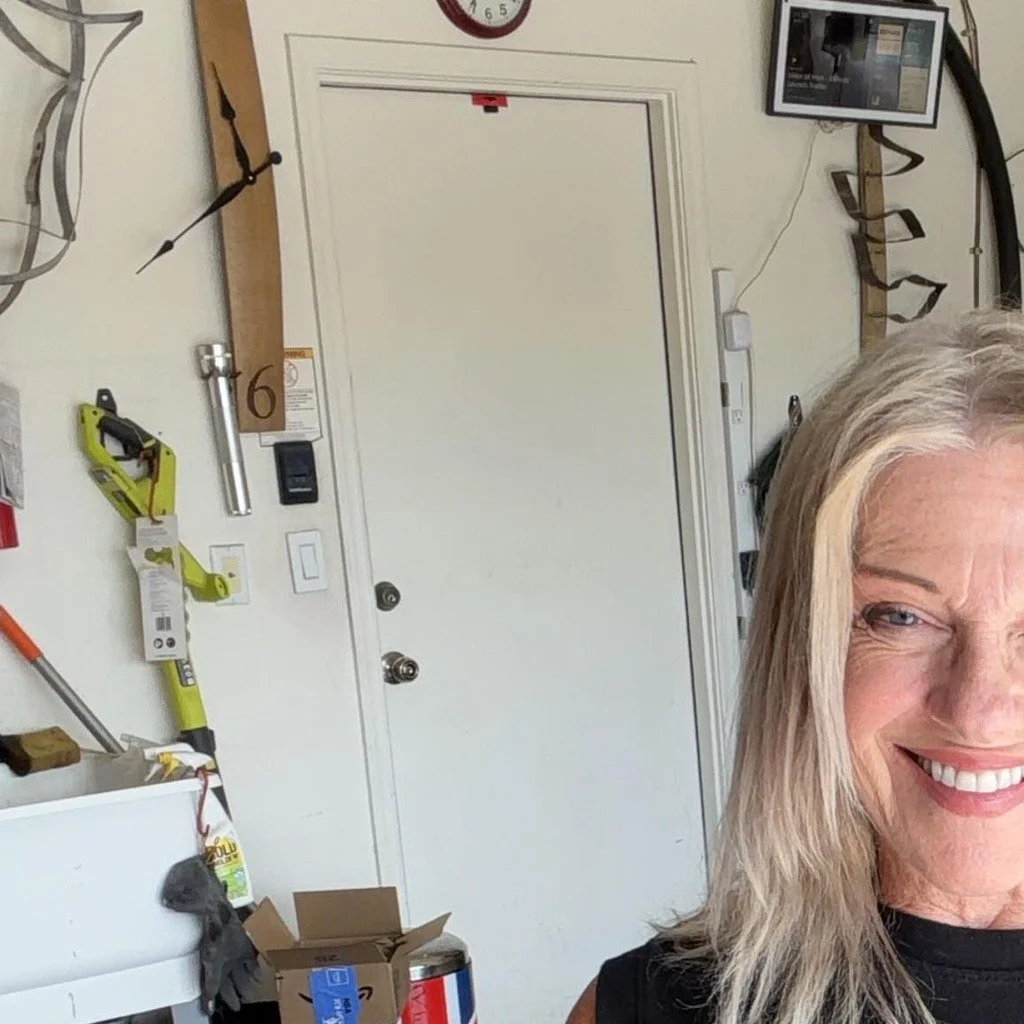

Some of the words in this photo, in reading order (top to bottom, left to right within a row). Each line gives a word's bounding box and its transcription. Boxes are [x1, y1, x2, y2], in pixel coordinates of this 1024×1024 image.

[485, 8, 492, 20] 6
[500, 4, 508, 16] 5
[246, 364, 277, 420] 6
